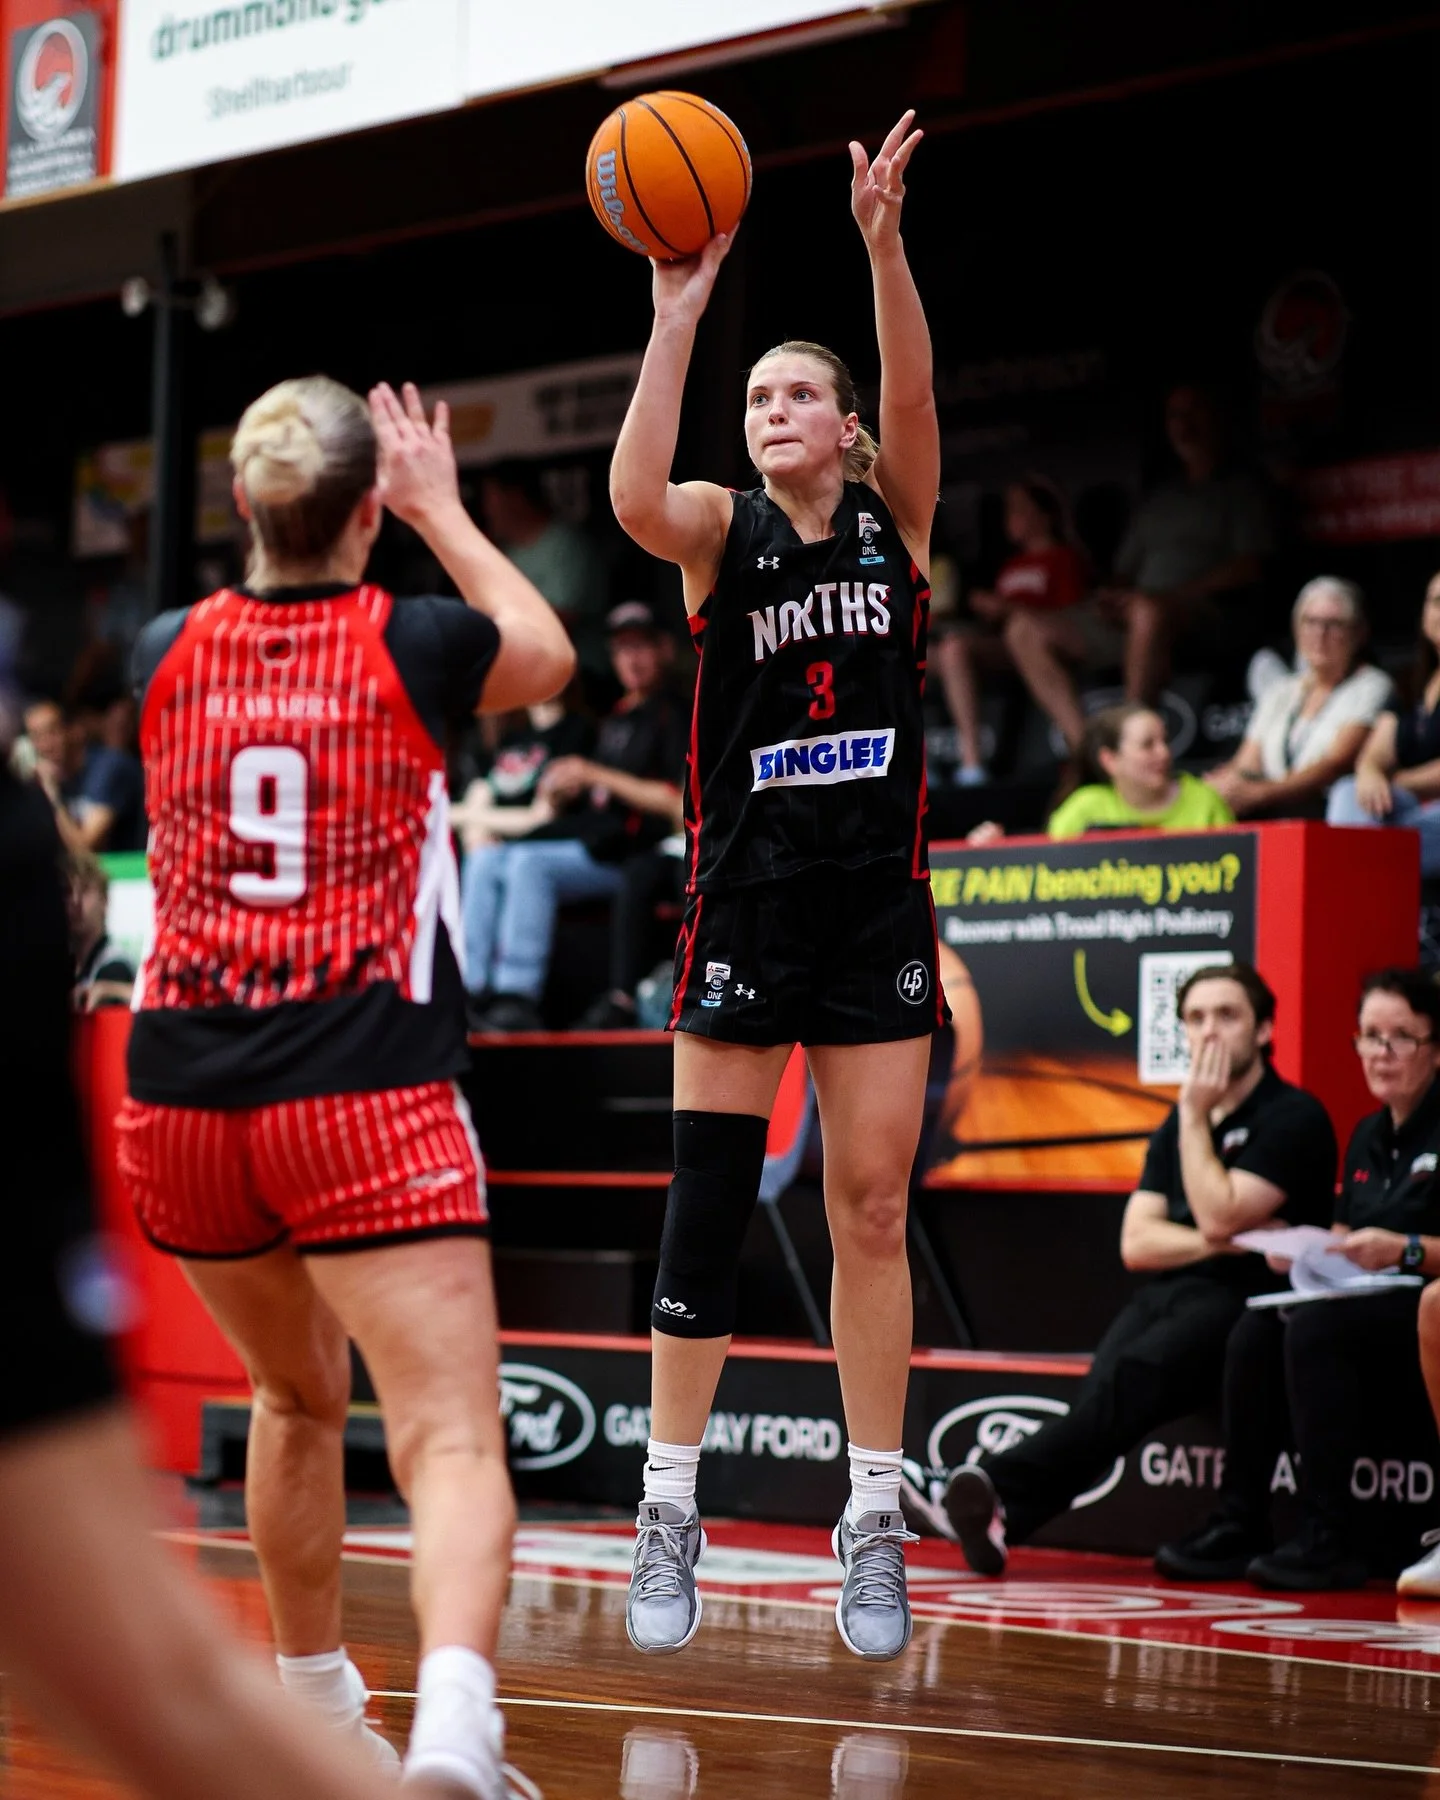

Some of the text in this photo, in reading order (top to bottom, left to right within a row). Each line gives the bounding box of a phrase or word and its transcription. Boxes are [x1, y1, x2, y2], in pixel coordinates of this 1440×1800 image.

[597, 148, 649, 252] Wilson
[862, 546, 878, 556] ONE
[747, 582, 892, 664] NORTHS
[805, 661, 836, 721] 3
[228, 744, 309, 908] 9
[962, 864, 1034, 905] PAIN
[1035, 858, 1163, 905] benching
[1166, 853, 1241, 904] you?
[707, 990, 724, 1000] ONE
[750, 1412, 842, 1462] FORD
[1349, 1456, 1435, 1503] ORD
